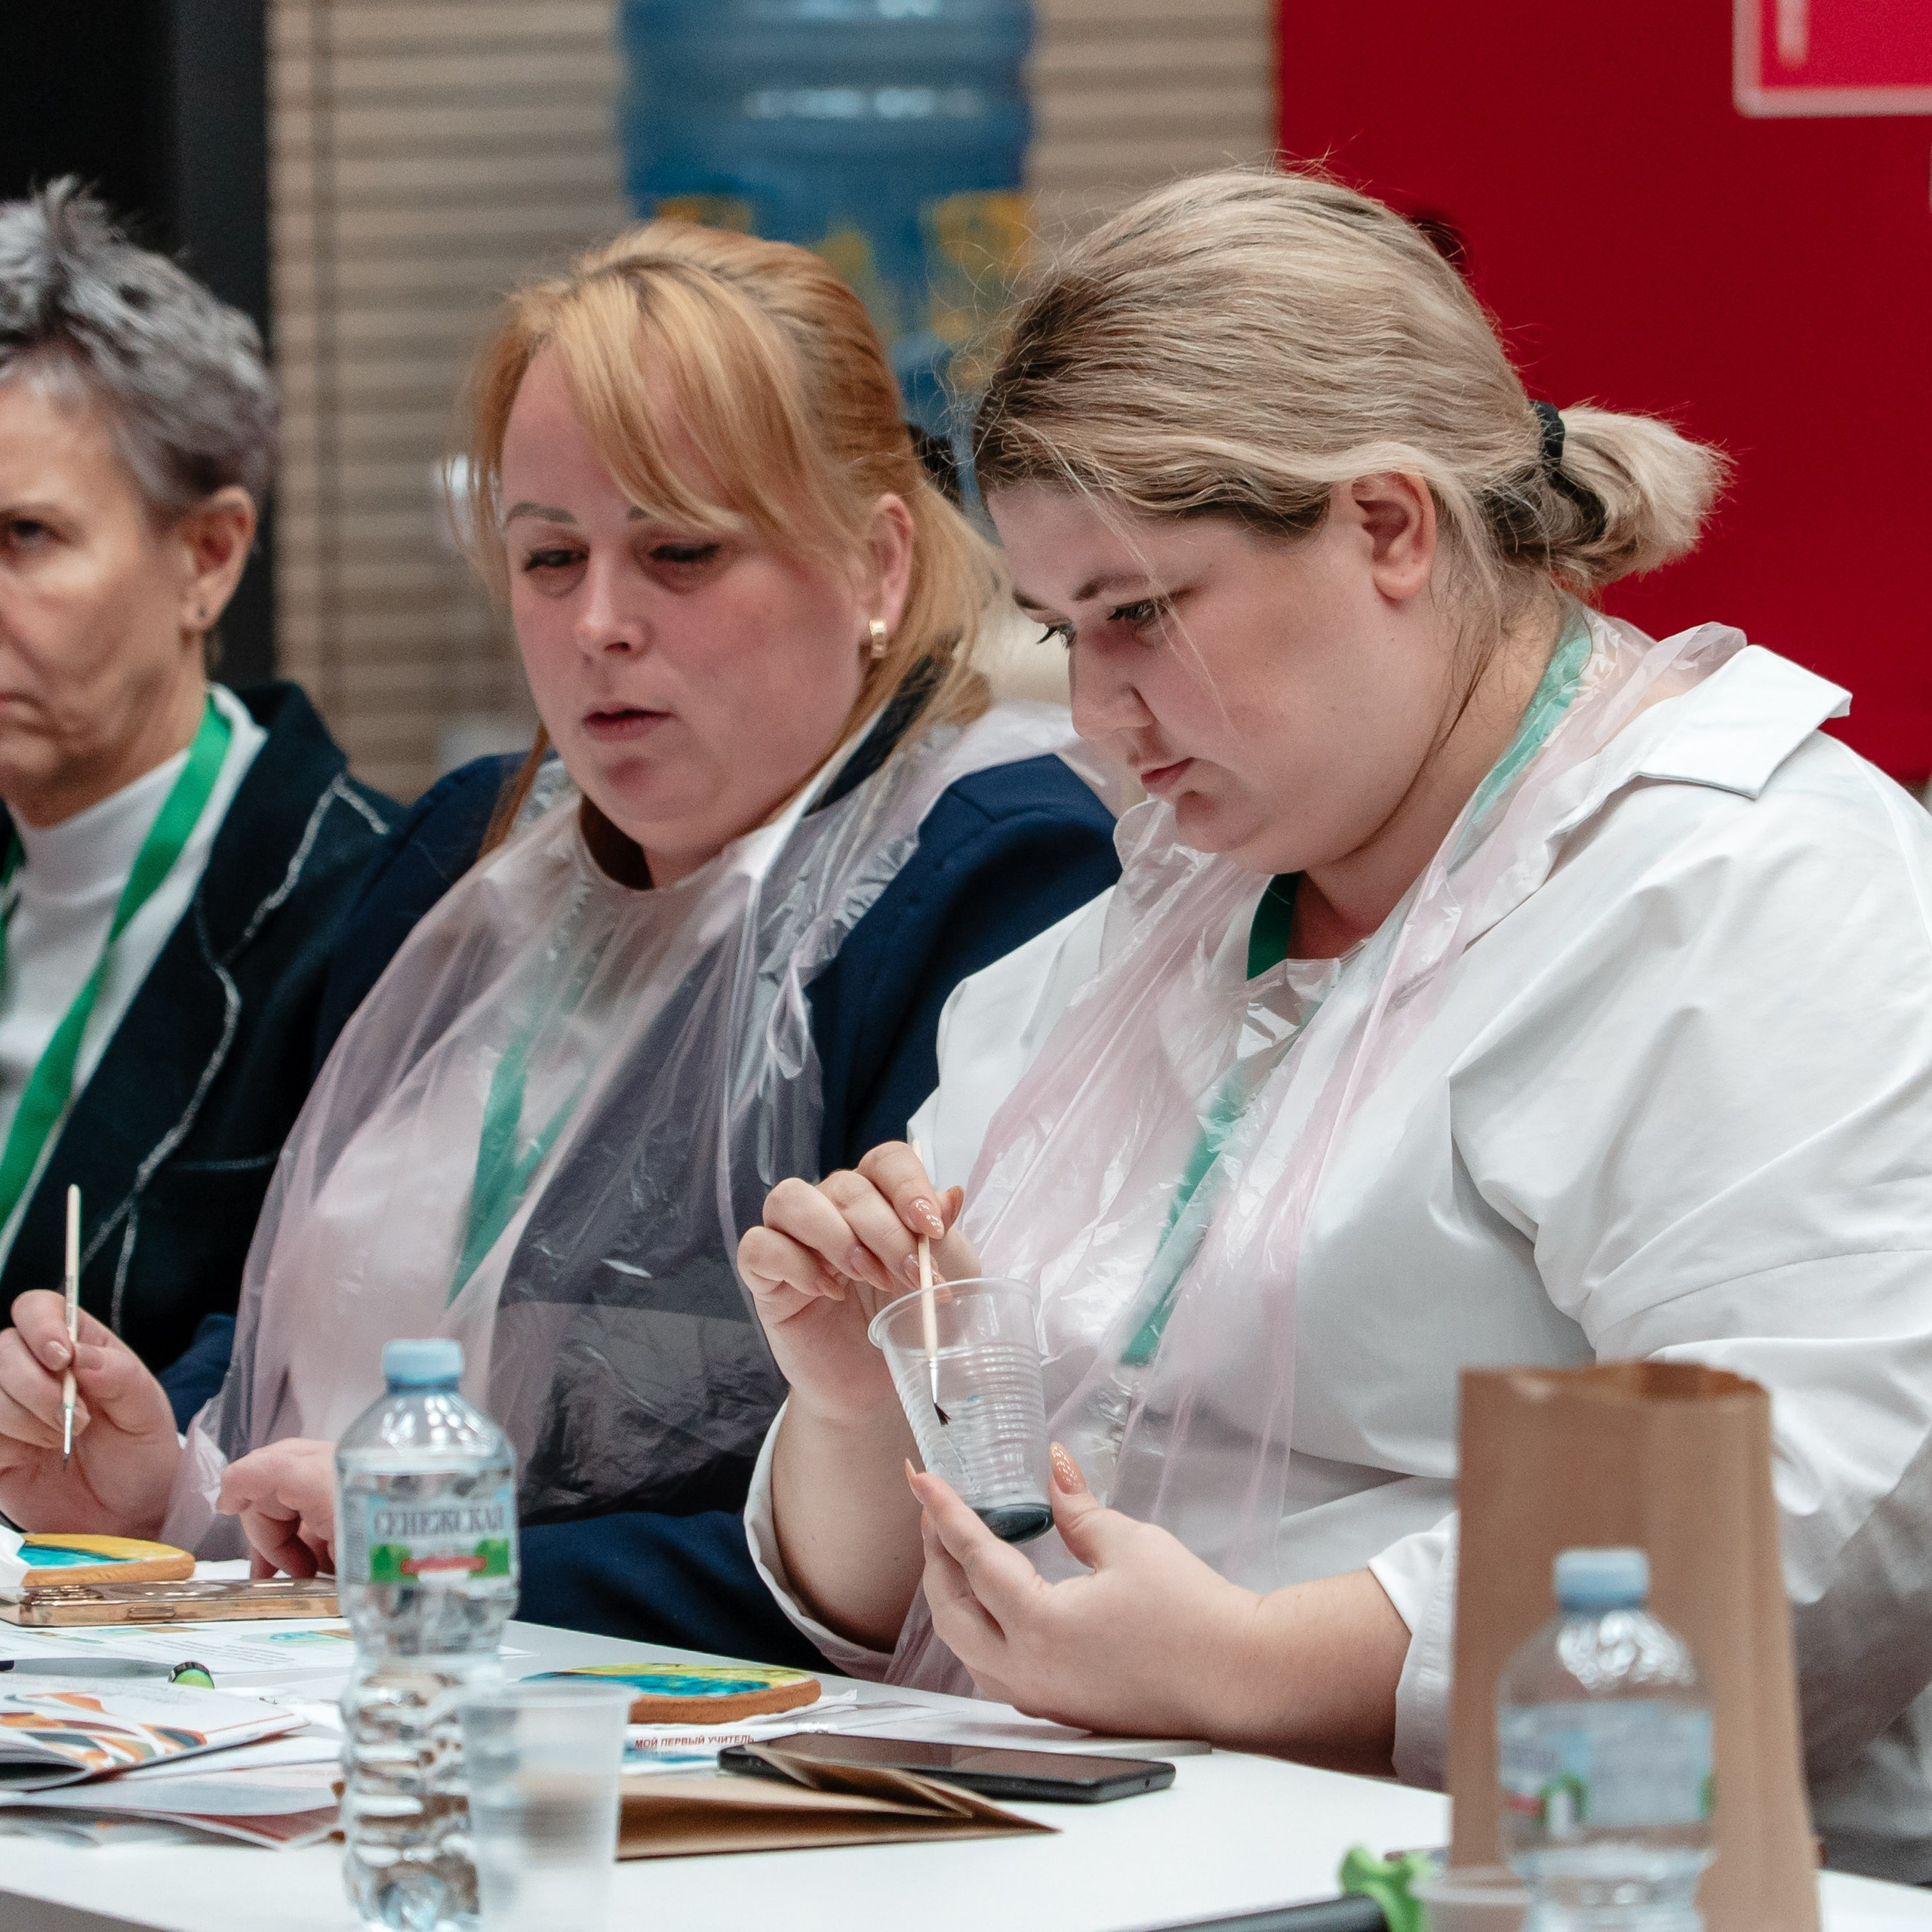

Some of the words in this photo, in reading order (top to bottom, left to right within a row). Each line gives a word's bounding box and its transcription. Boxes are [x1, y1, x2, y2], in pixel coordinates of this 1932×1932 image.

[635, 1737, 658, 1749] МОЙ
[660, 1735, 705, 1746] ПЕРВЫЙ
[708, 1734, 754, 1744] УЧИТЕЛЬ
